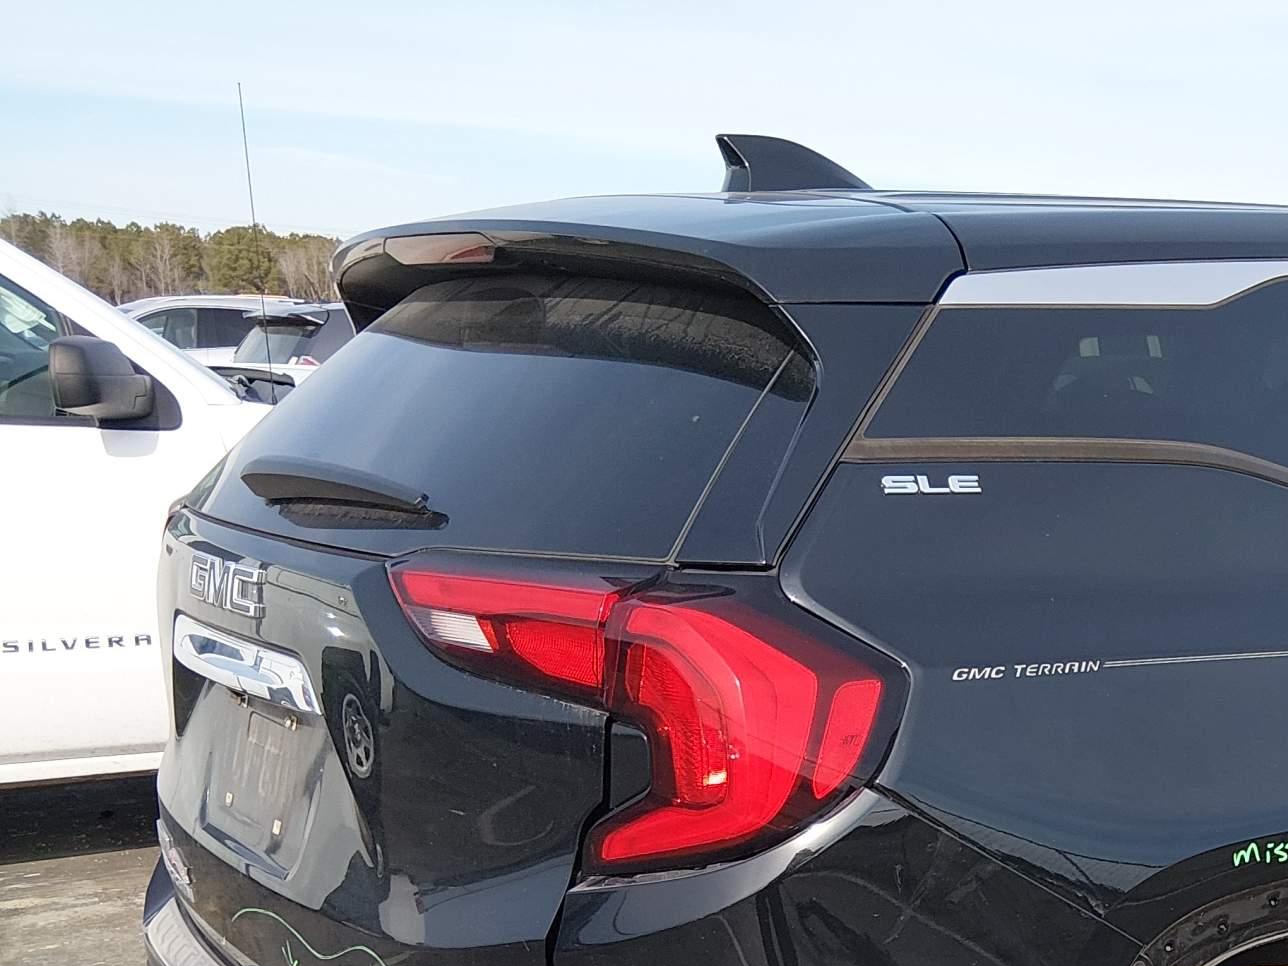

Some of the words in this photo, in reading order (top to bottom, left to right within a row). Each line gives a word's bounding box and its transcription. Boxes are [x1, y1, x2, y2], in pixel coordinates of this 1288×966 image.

[881, 475, 982, 494] SLE
[190, 552, 266, 618] GMC
[2, 634, 152, 653] SILVERA
[952, 666, 1005, 681] GMC
[1014, 660, 1100, 678] TERRAIN
